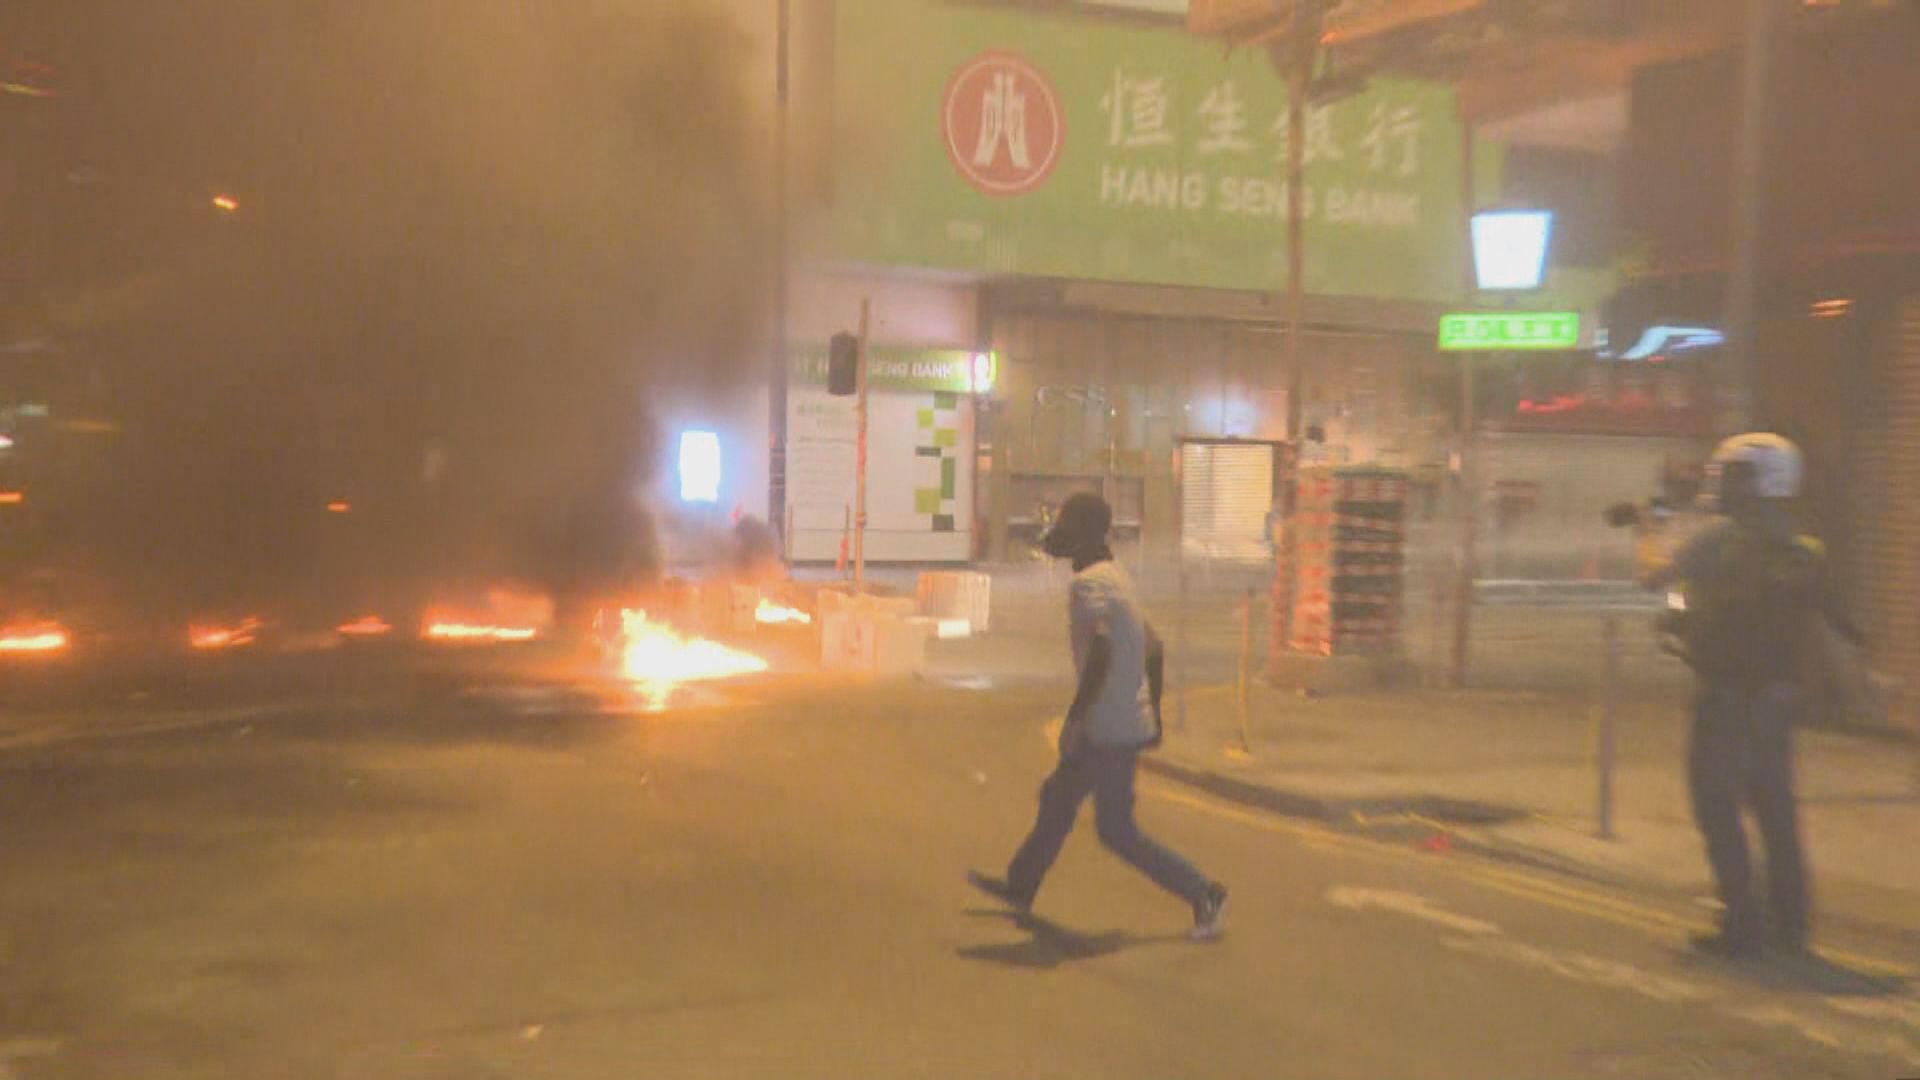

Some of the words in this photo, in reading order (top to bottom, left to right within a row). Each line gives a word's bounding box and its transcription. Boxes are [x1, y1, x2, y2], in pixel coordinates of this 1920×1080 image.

[1101, 163, 1207, 210] HANG
[1326, 187, 1419, 226] BANK
[911, 360, 954, 379] BANK
